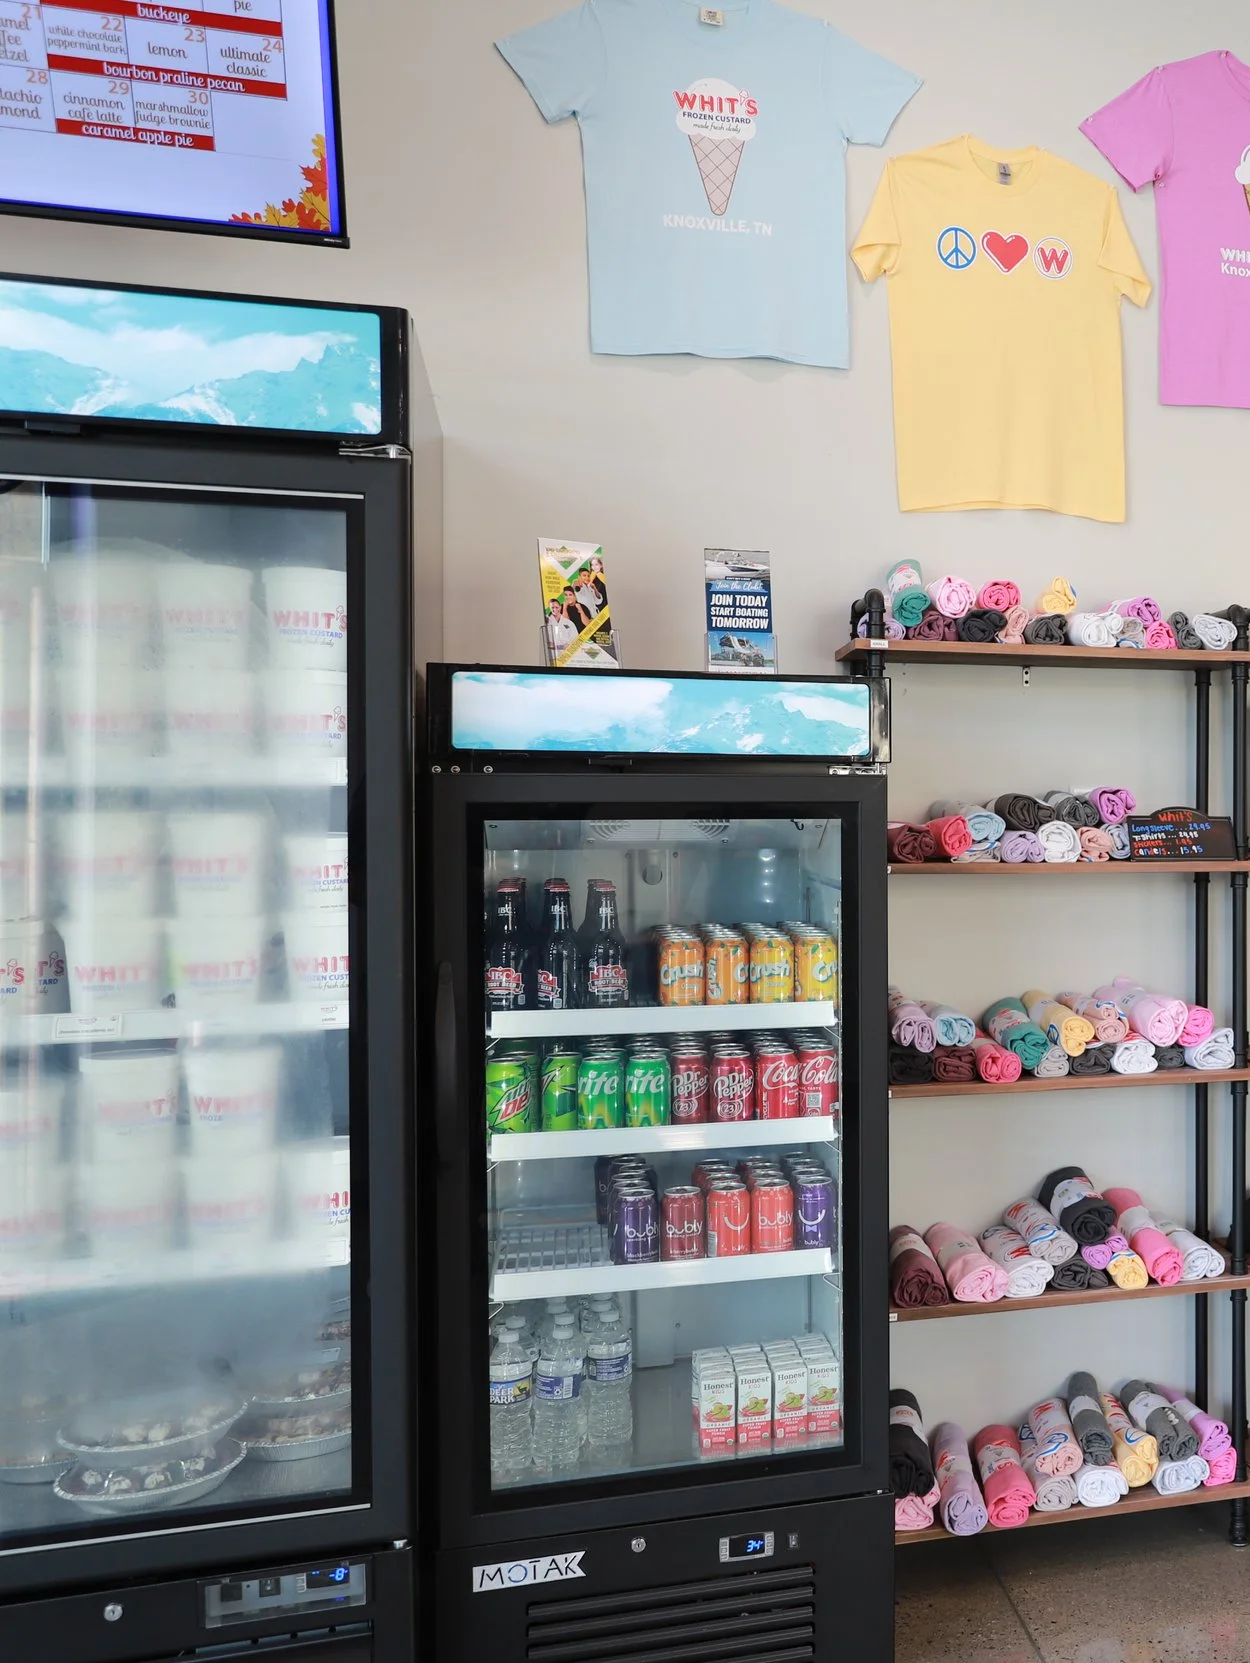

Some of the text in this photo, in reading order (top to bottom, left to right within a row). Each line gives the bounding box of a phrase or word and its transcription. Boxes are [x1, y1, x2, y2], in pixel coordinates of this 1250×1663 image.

[137, 4, 191, 24] buckeye
[101, 16, 123, 32] 22
[48, 26, 123, 43] white chocolate
[184, 27, 205, 43] 23
[47, 37, 128, 55] peppermint bark
[147, 41, 188, 59] lemon
[263, 38, 283, 53] 24
[220, 47, 271, 63] ultimate
[26, 69, 48, 84] 28
[103, 62, 245, 92] bourbon praline pecan
[226, 62, 267, 78] classic
[108, 80, 130, 96] 29
[63, 91, 125, 111] cinnamon
[188, 90, 209, 105] 30
[672, 88, 759, 117] WHIT'S
[96, 109, 124, 124] latte
[136, 100, 209, 117] marshmallow
[135, 110, 211, 130] fudge brownie
[682, 111, 751, 125] FROZEN CUSTARD
[82, 124, 195, 147] caramel apple pie
[662, 214, 773, 236] KNOXVILLE, TN
[1037, 245, 1069, 274] W
[730, 581, 742, 590] the
[710, 594, 768, 607] JOIN TODAY
[711, 607, 768, 617] START BOATING
[711, 617, 769, 629] TOMORROW
[1180, 845, 1203, 855] 15.95
[491, 971, 511, 980] IBC
[600, 969, 619, 977] IBC
[660, 960, 704, 985] Crush
[750, 960, 790, 983] Crush
[685, 1071, 700, 1081] Dr
[728, 1072, 745, 1083] Dr
[672, 1074, 709, 1099] Pepper
[714, 1076, 753, 1100] Pepper
[679, 1103, 689, 1112] 23
[724, 1104, 735, 1113] 23
[758, 1212, 793, 1226] bubly
[666, 1219, 703, 1237] bubly
[777, 1372, 805, 1381] Honest
[810, 1367, 838, 1375] Honest
[740, 1376, 769, 1385] Honest
[490, 1388, 513, 1396] DEER
[490, 1395, 515, 1404] PARK
[479, 1555, 577, 1588] MOTAK
